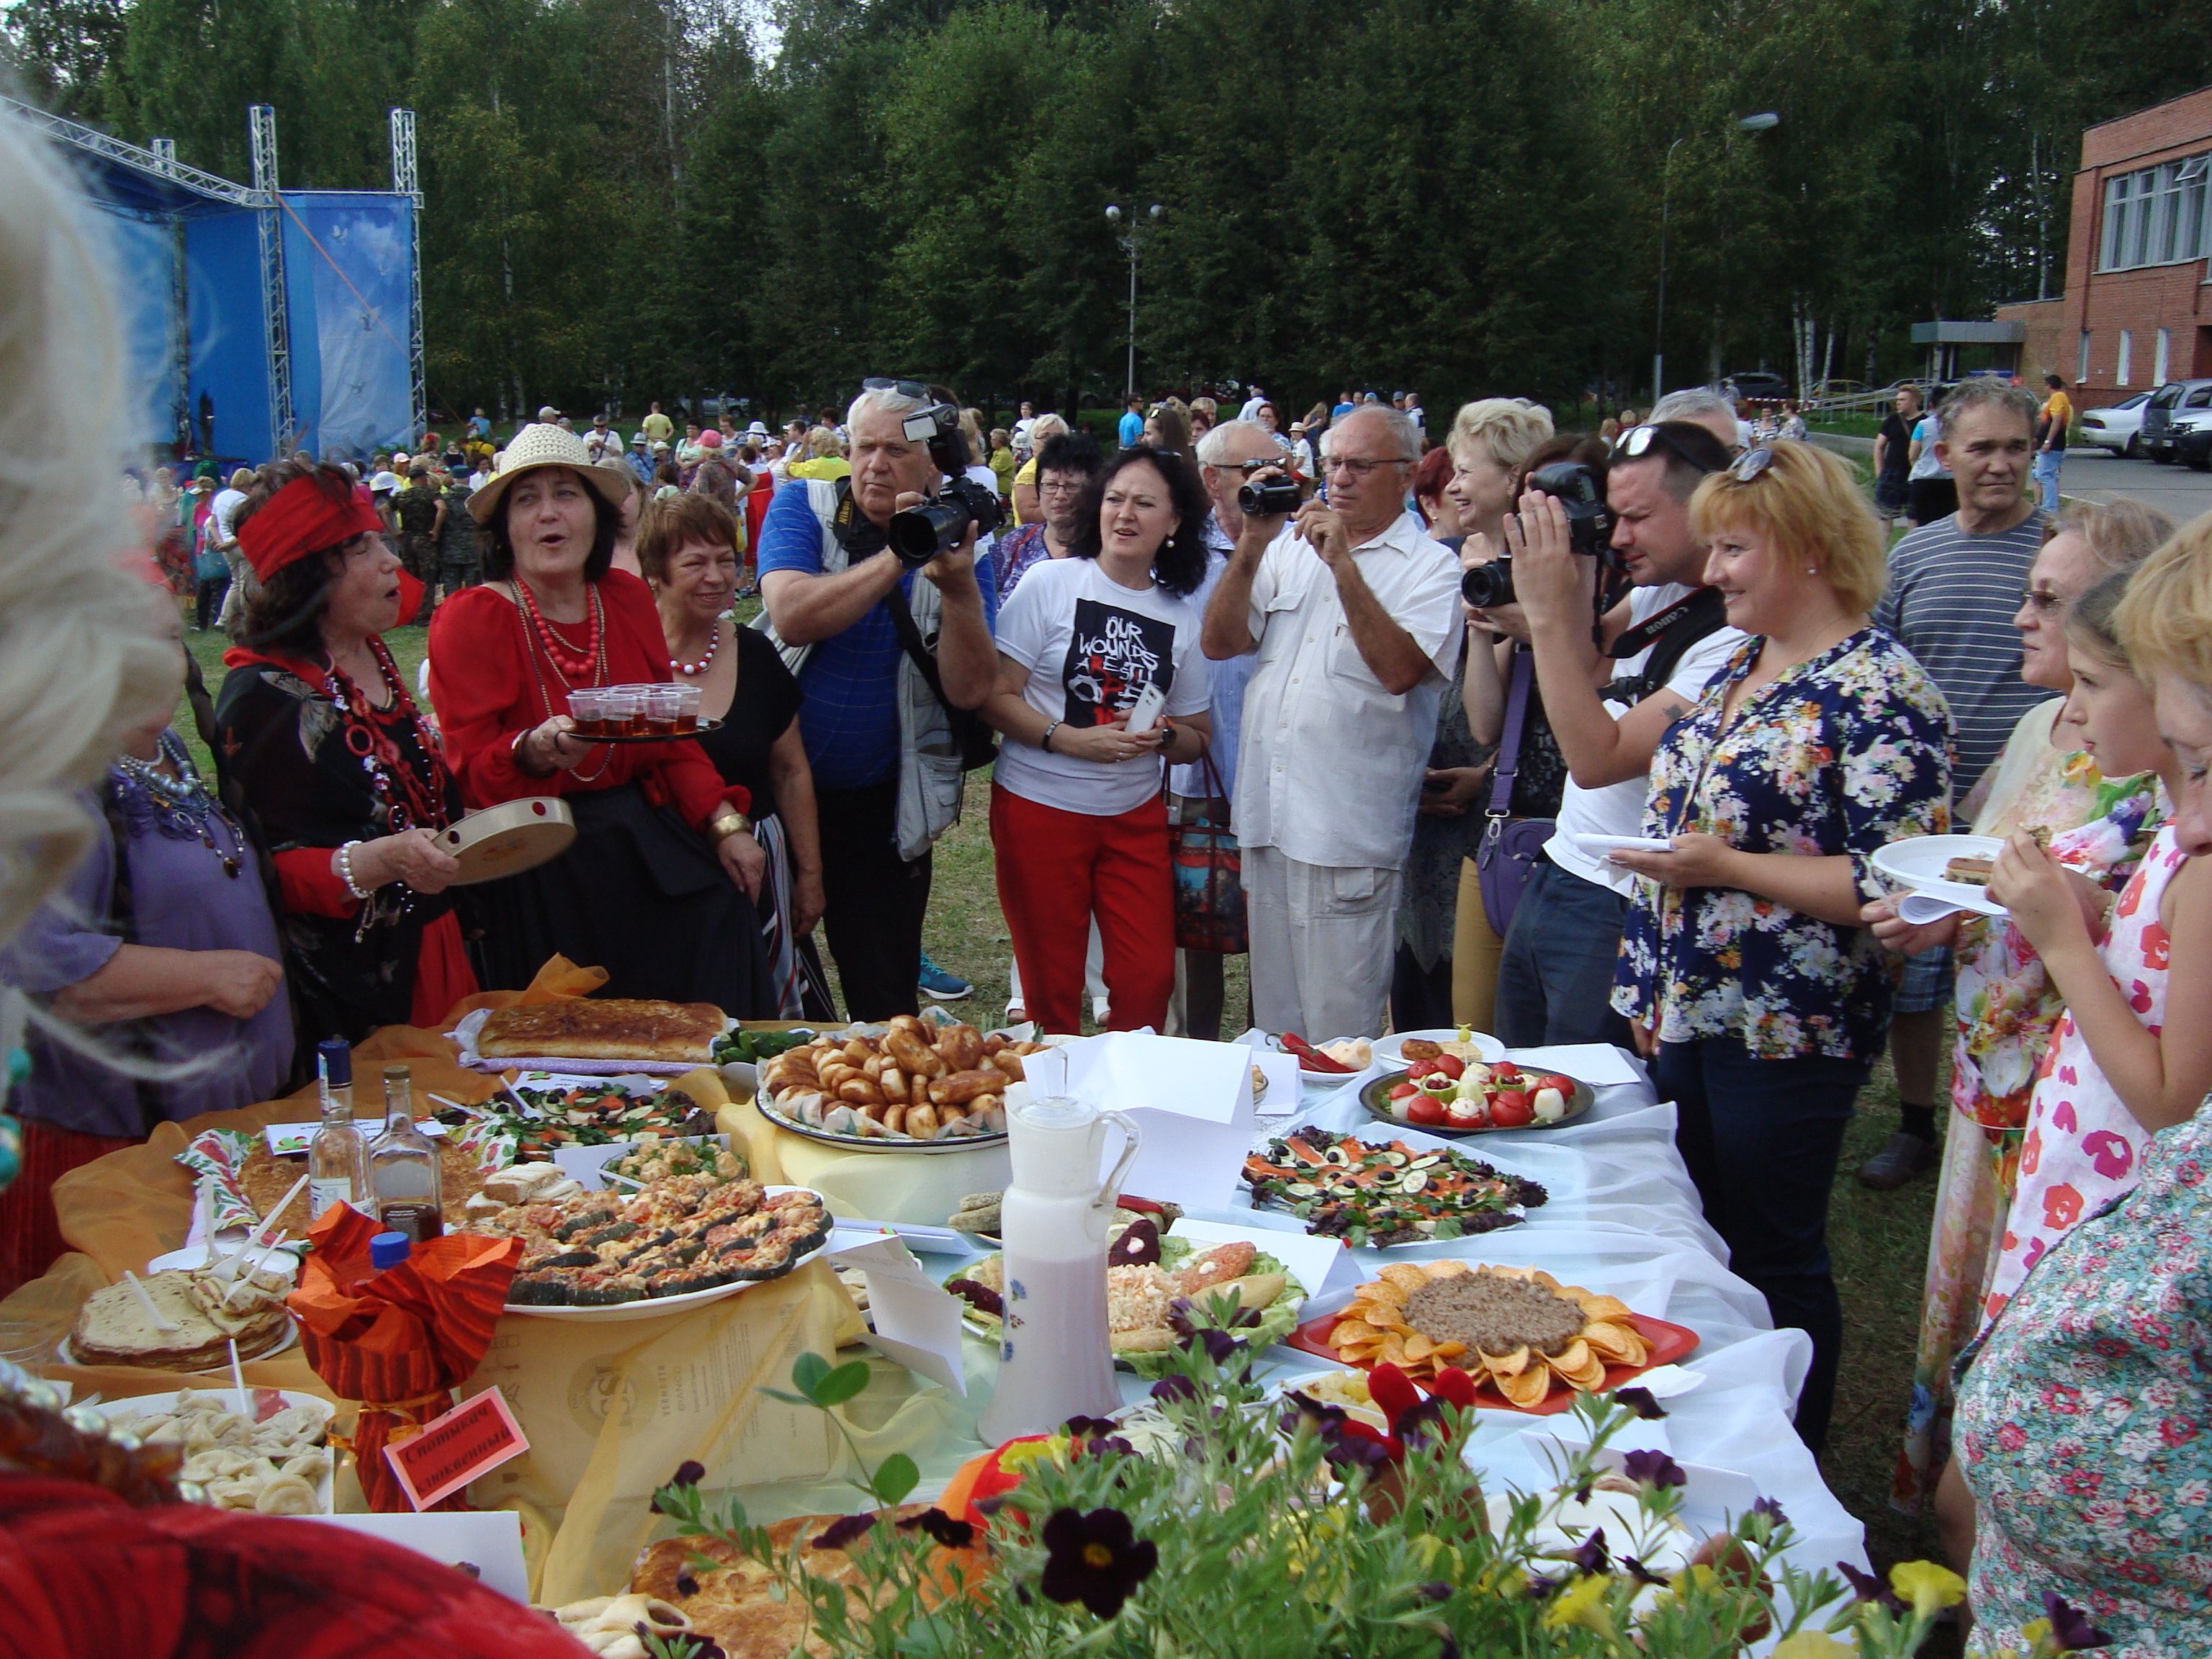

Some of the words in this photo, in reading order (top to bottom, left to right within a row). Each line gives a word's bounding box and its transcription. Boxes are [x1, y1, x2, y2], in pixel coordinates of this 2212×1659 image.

[838, 500, 851, 525] Nikon
[1105, 616, 1147, 650] OUR
[1645, 606, 1689, 634] Canon
[1079, 633, 1159, 671] WOUNDS
[405, 1406, 489, 1464] Спотыкач
